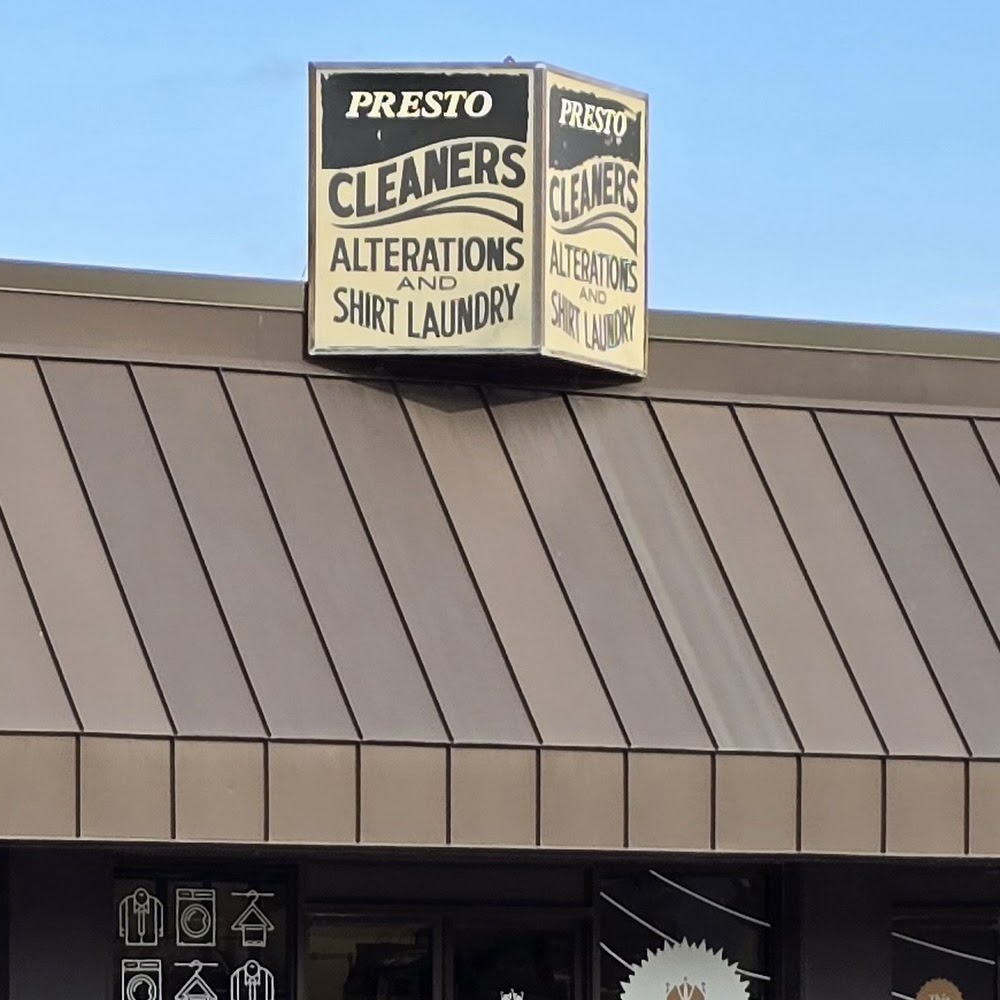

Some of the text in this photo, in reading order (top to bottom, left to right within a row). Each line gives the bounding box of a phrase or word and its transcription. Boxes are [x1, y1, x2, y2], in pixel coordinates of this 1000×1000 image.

[345, 90, 493, 119] PRESTO
[558, 98, 628, 138] PRESTO
[328, 141, 527, 218] CLEANERS
[549, 161, 639, 223] CLEANERS
[330, 236, 525, 272] ALTERATIONS
[549, 239, 638, 294] ALTERATIONS
[397, 276, 458, 291] AND
[578, 287, 608, 305] AND
[333, 282, 521, 339] SHIRT LAUNDRY
[551, 289, 636, 352] SHIRT LAUNDRY
